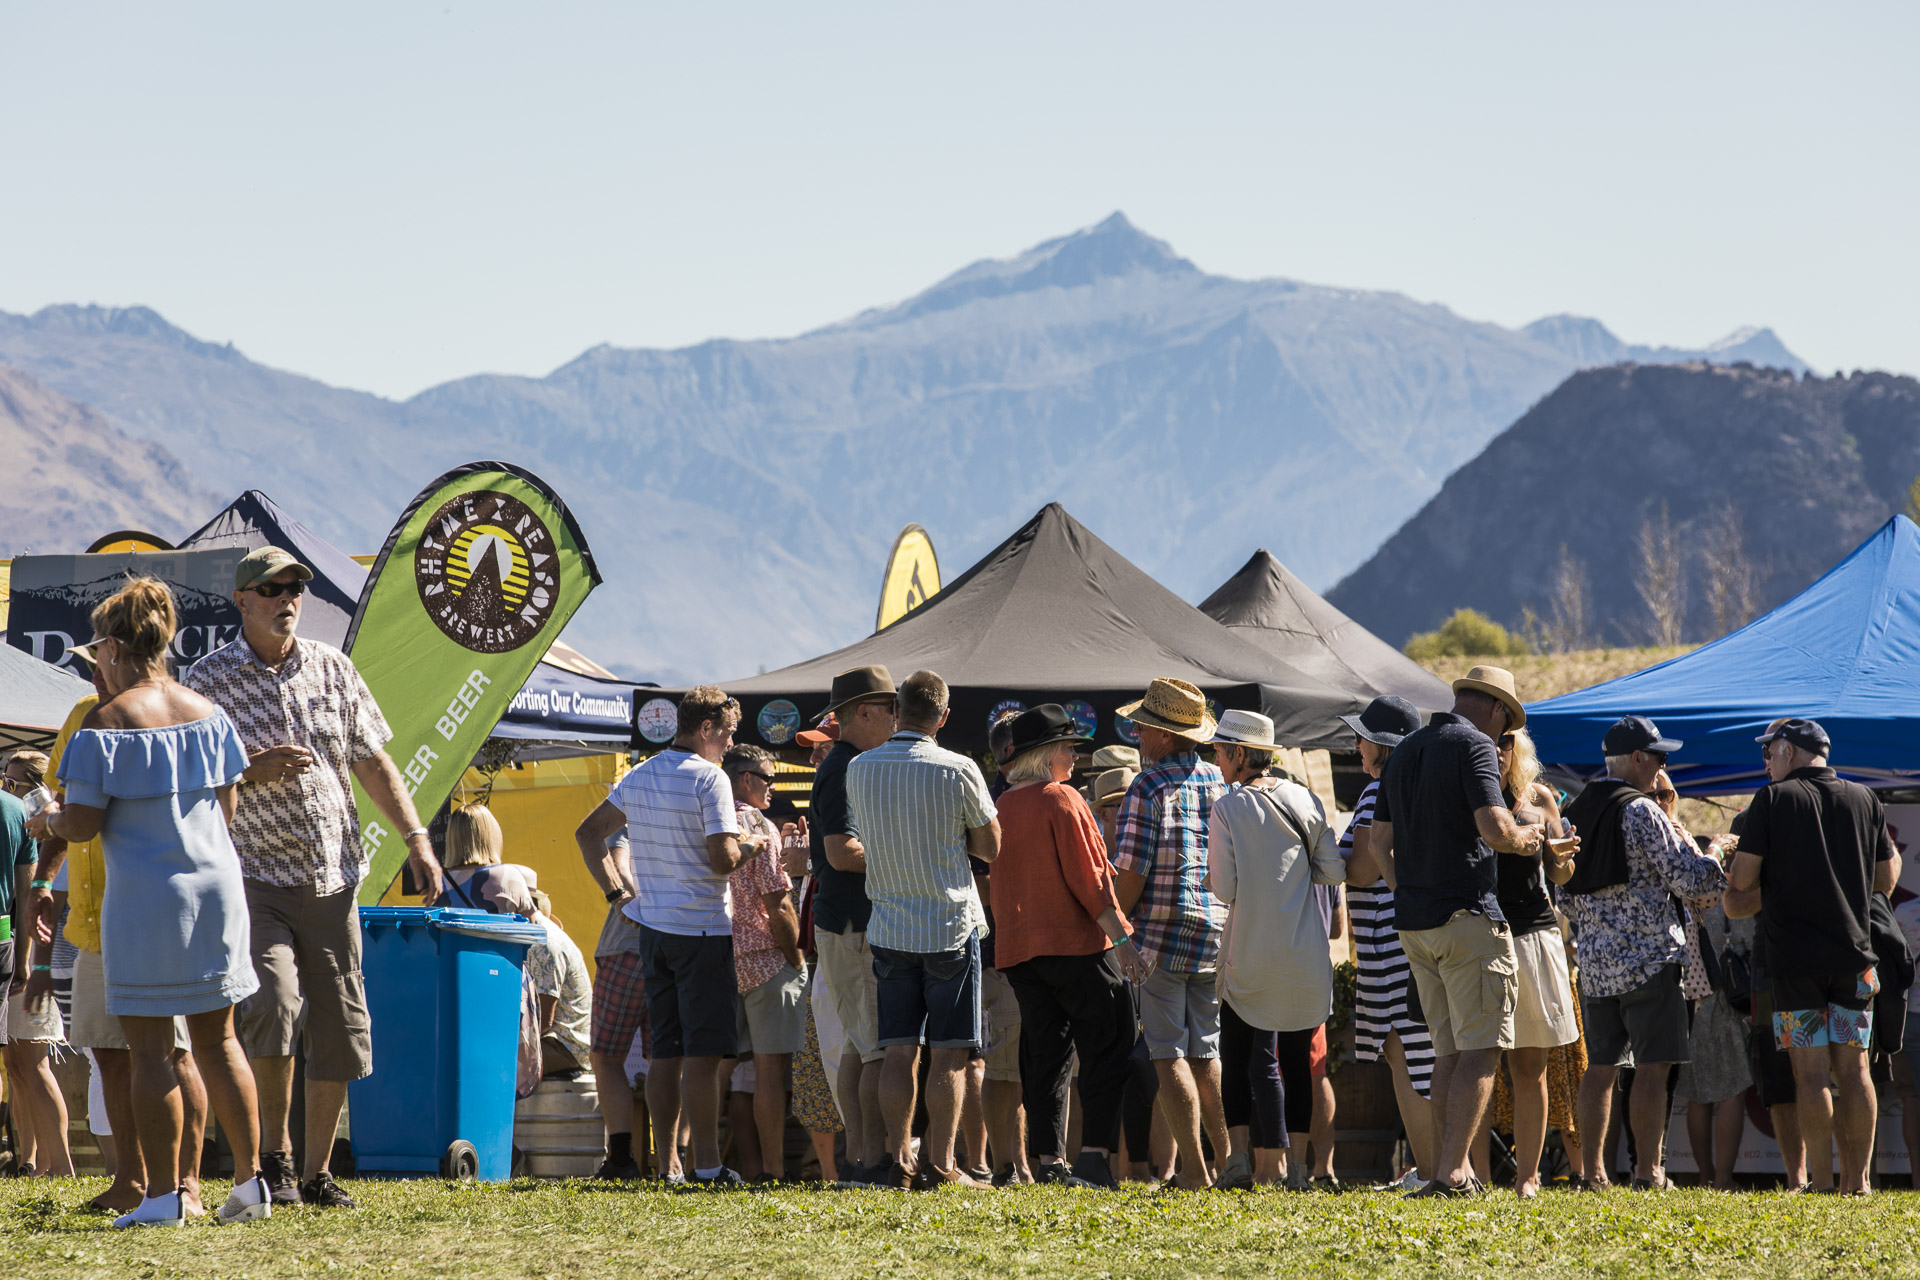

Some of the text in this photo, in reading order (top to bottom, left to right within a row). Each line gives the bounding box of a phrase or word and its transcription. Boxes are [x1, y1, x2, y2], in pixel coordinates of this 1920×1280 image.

[420, 499, 479, 597] RHYME
[514, 513, 554, 629] REASON
[440, 605, 515, 644] BREWERY
[434, 668, 492, 741] BEER
[550, 689, 571, 714] Our
[572, 691, 631, 723] Community
[997, 700, 1021, 711] ALPHA
